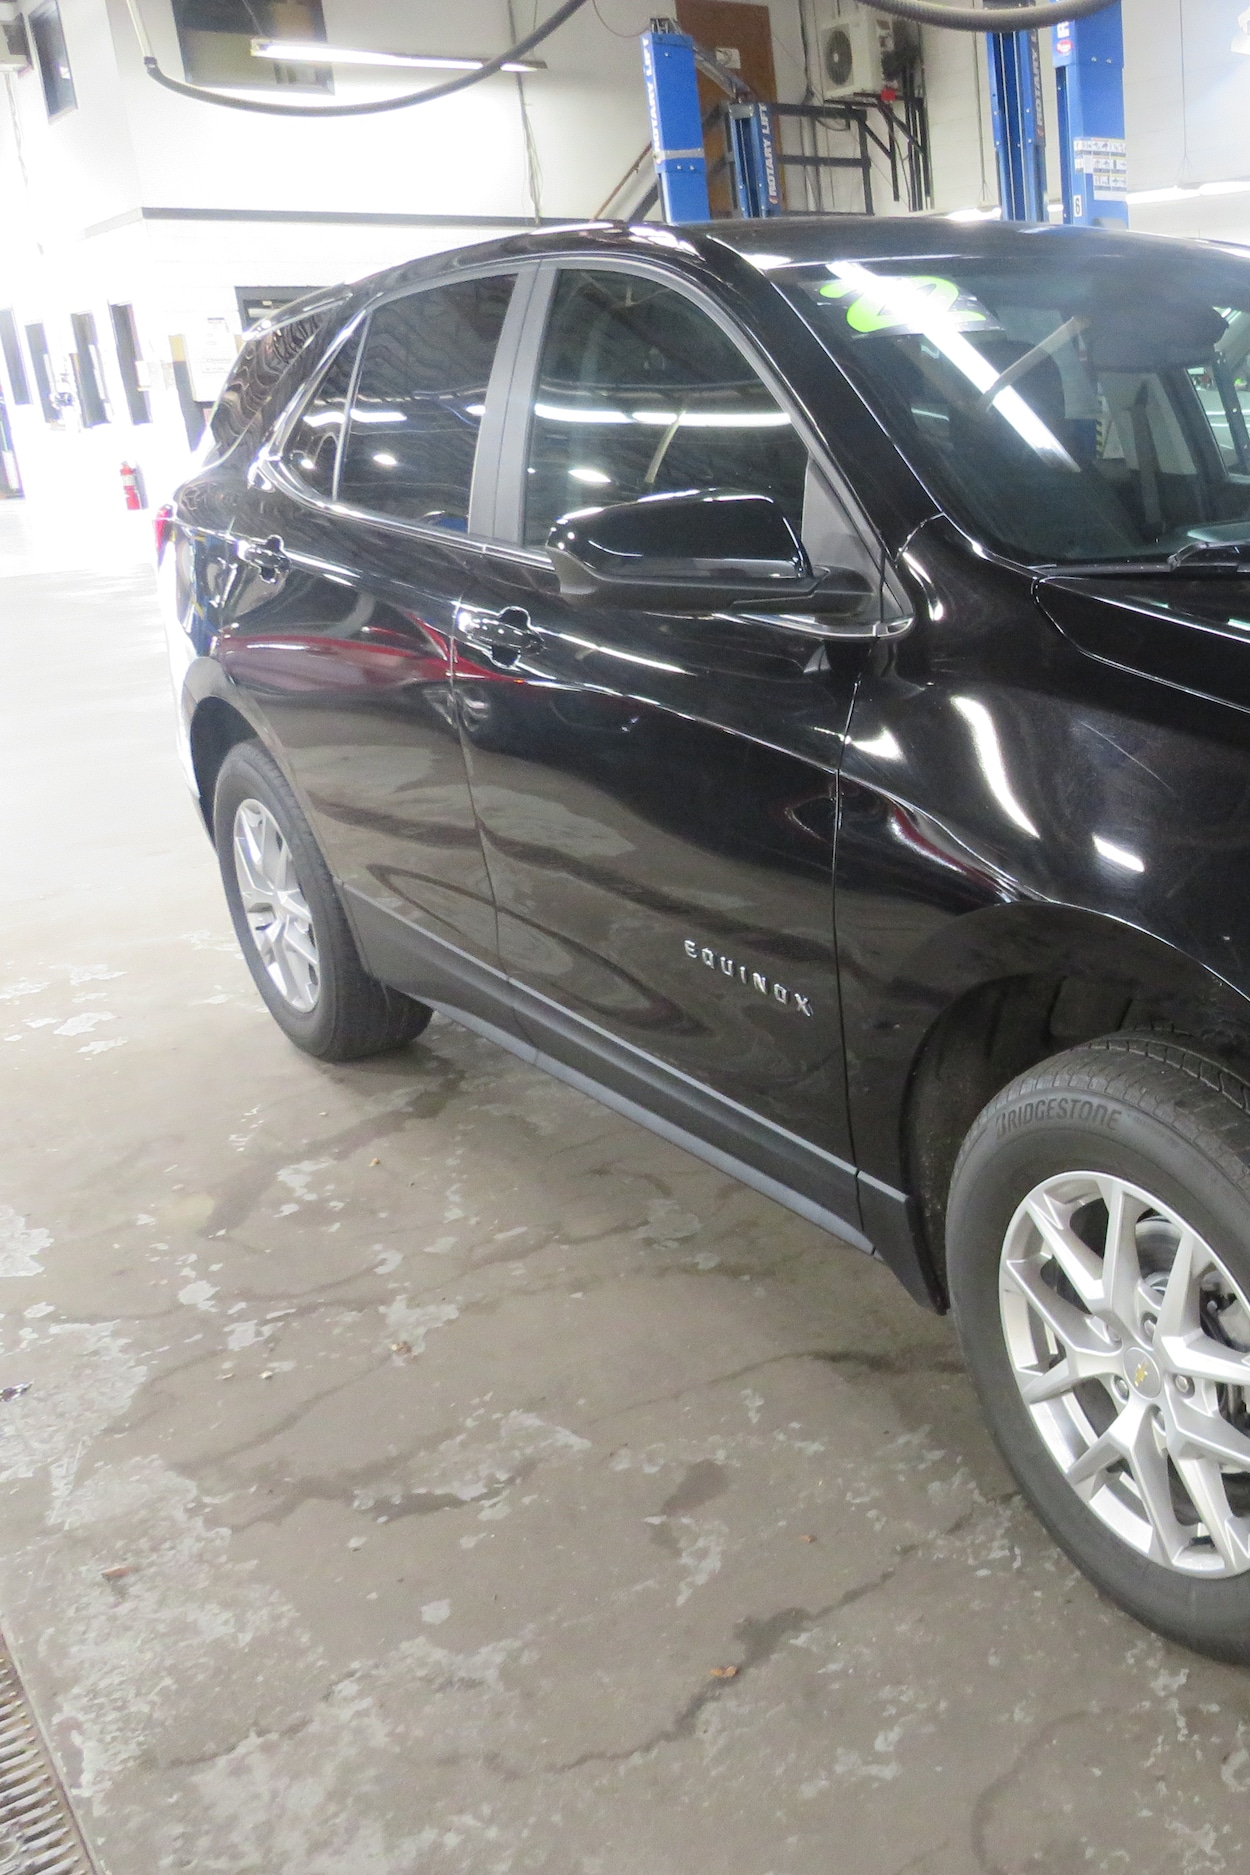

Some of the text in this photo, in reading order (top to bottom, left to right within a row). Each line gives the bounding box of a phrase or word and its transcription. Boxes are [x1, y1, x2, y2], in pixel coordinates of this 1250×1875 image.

[641, 37, 662, 153] ROTARY LIFT
[758, 102, 777, 196] ROTARY LIFT
[1074, 196, 1082, 216] 6
[684, 939, 814, 1017] EQUINOX
[995, 1097, 1123, 1141] BRIDGESTONE
